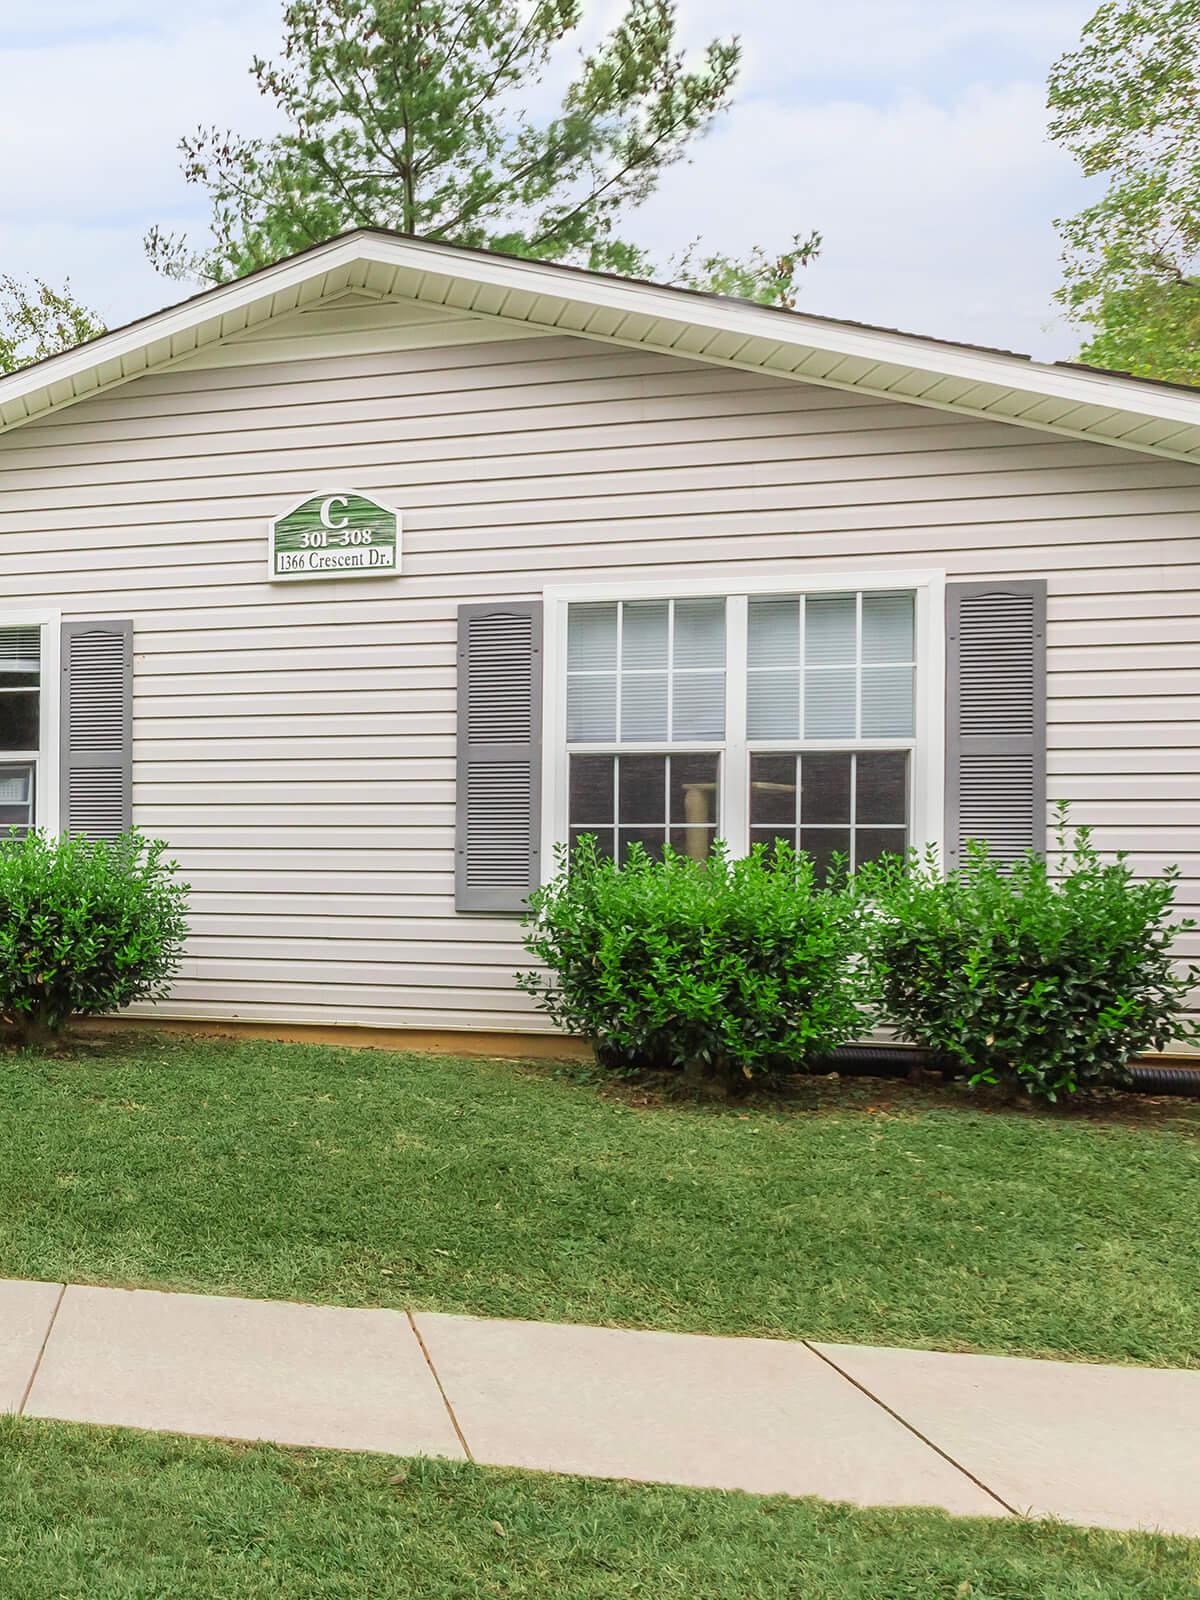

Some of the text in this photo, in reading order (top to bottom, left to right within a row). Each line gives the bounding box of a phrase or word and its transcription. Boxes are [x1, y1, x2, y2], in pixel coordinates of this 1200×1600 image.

[320, 496, 349, 529] C
[300, 529, 372, 548] 301-308
[280, 549, 390, 570] 1366 Crescent Dr.
